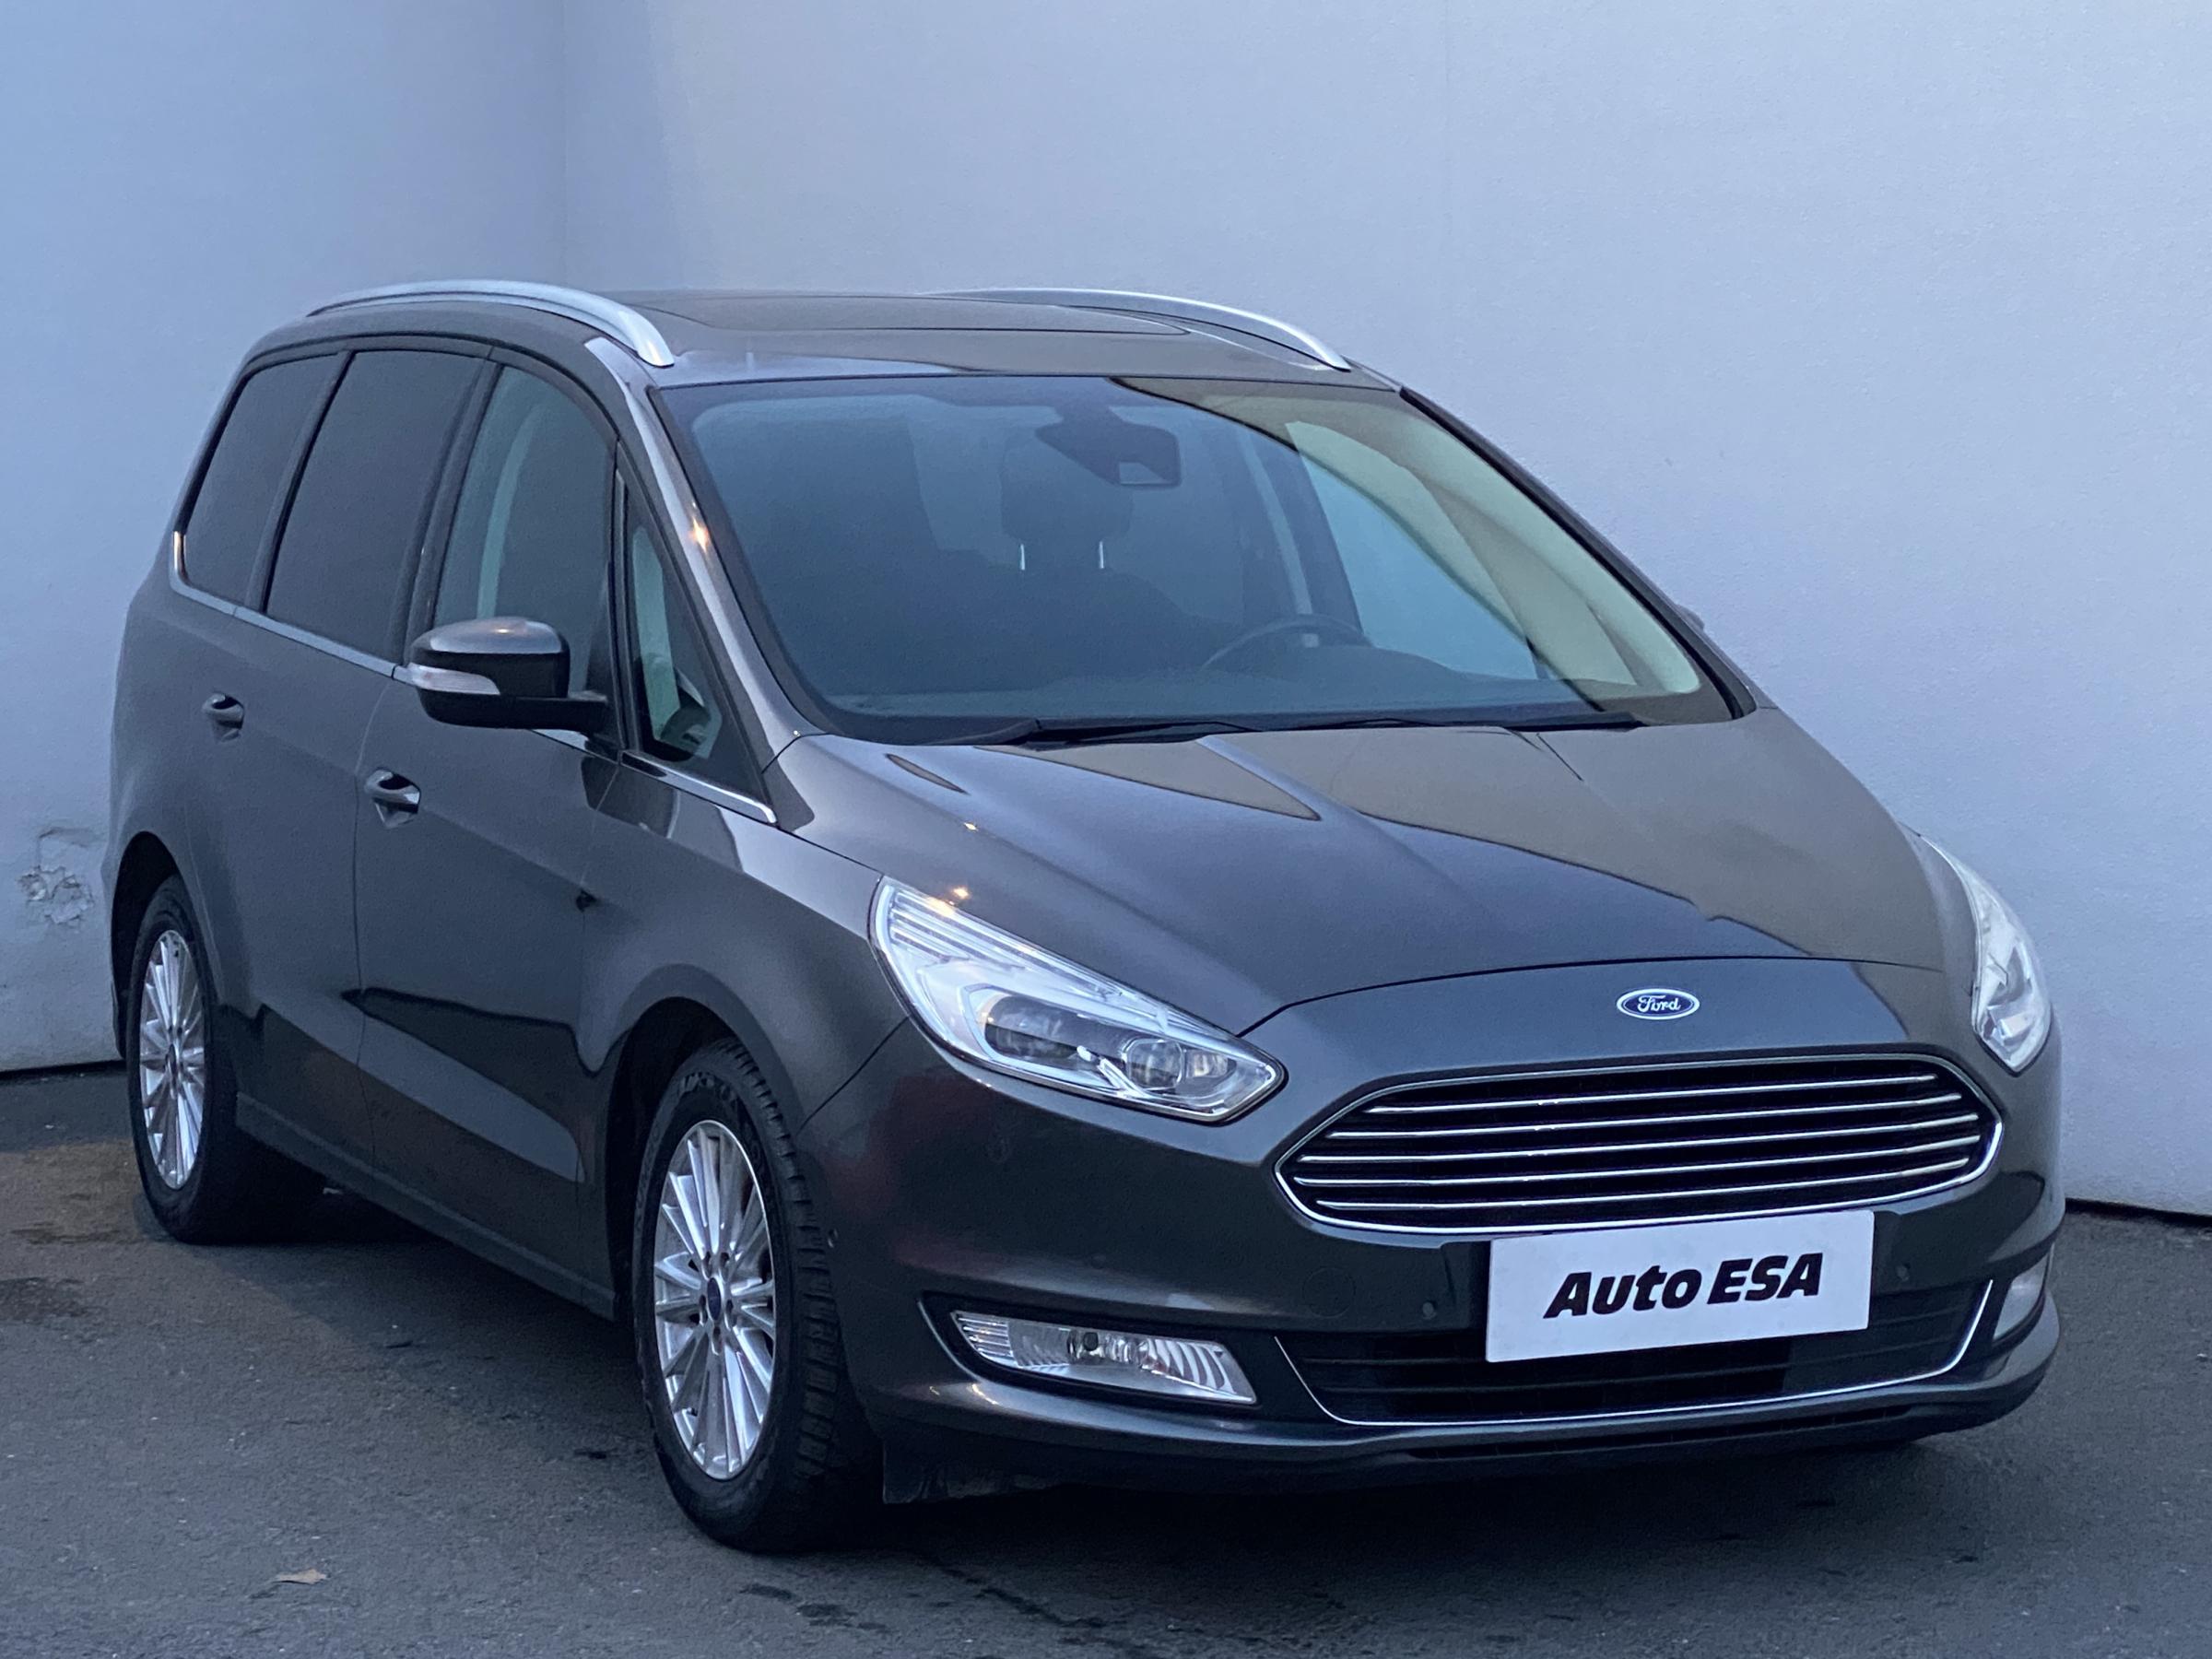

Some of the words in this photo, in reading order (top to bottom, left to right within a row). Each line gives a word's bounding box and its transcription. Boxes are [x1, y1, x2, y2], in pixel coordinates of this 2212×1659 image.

[1637, 994, 1681, 1013] Ford
[1543, 1265, 1702, 1319] Auto
[1707, 1253, 1823, 1305] ESA
